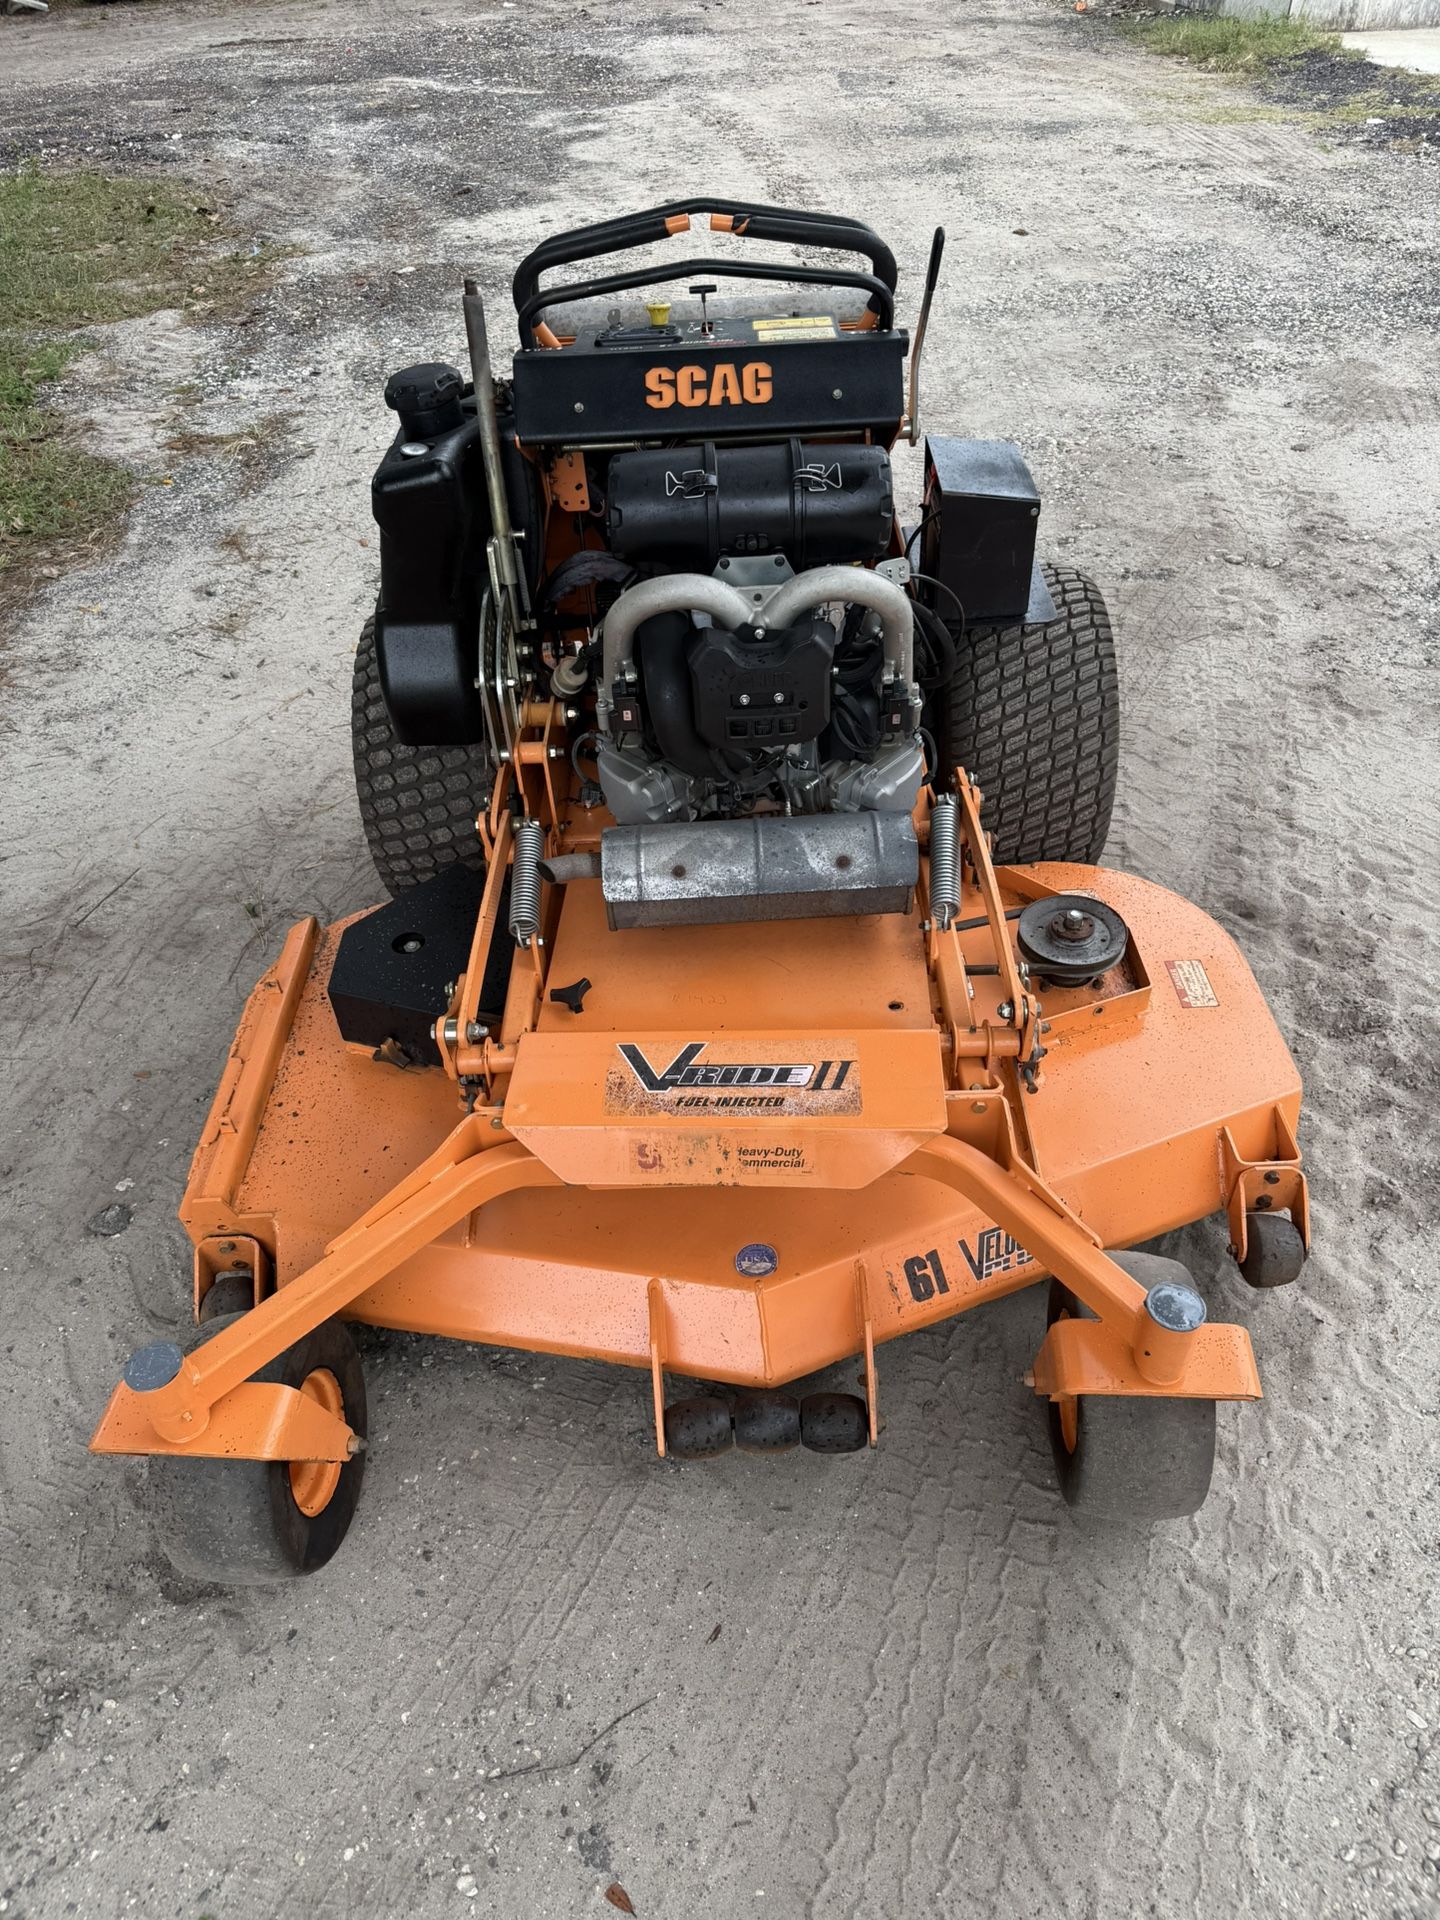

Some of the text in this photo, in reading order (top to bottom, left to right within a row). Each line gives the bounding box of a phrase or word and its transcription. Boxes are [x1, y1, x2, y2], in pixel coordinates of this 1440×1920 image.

[645, 362, 773, 409] SCAG
[616, 1042, 858, 1093] V-RIDE II
[675, 1096, 785, 1108] FUEL-INJECTED
[738, 1158, 805, 1168] ommercial
[903, 1249, 950, 1302] 61
